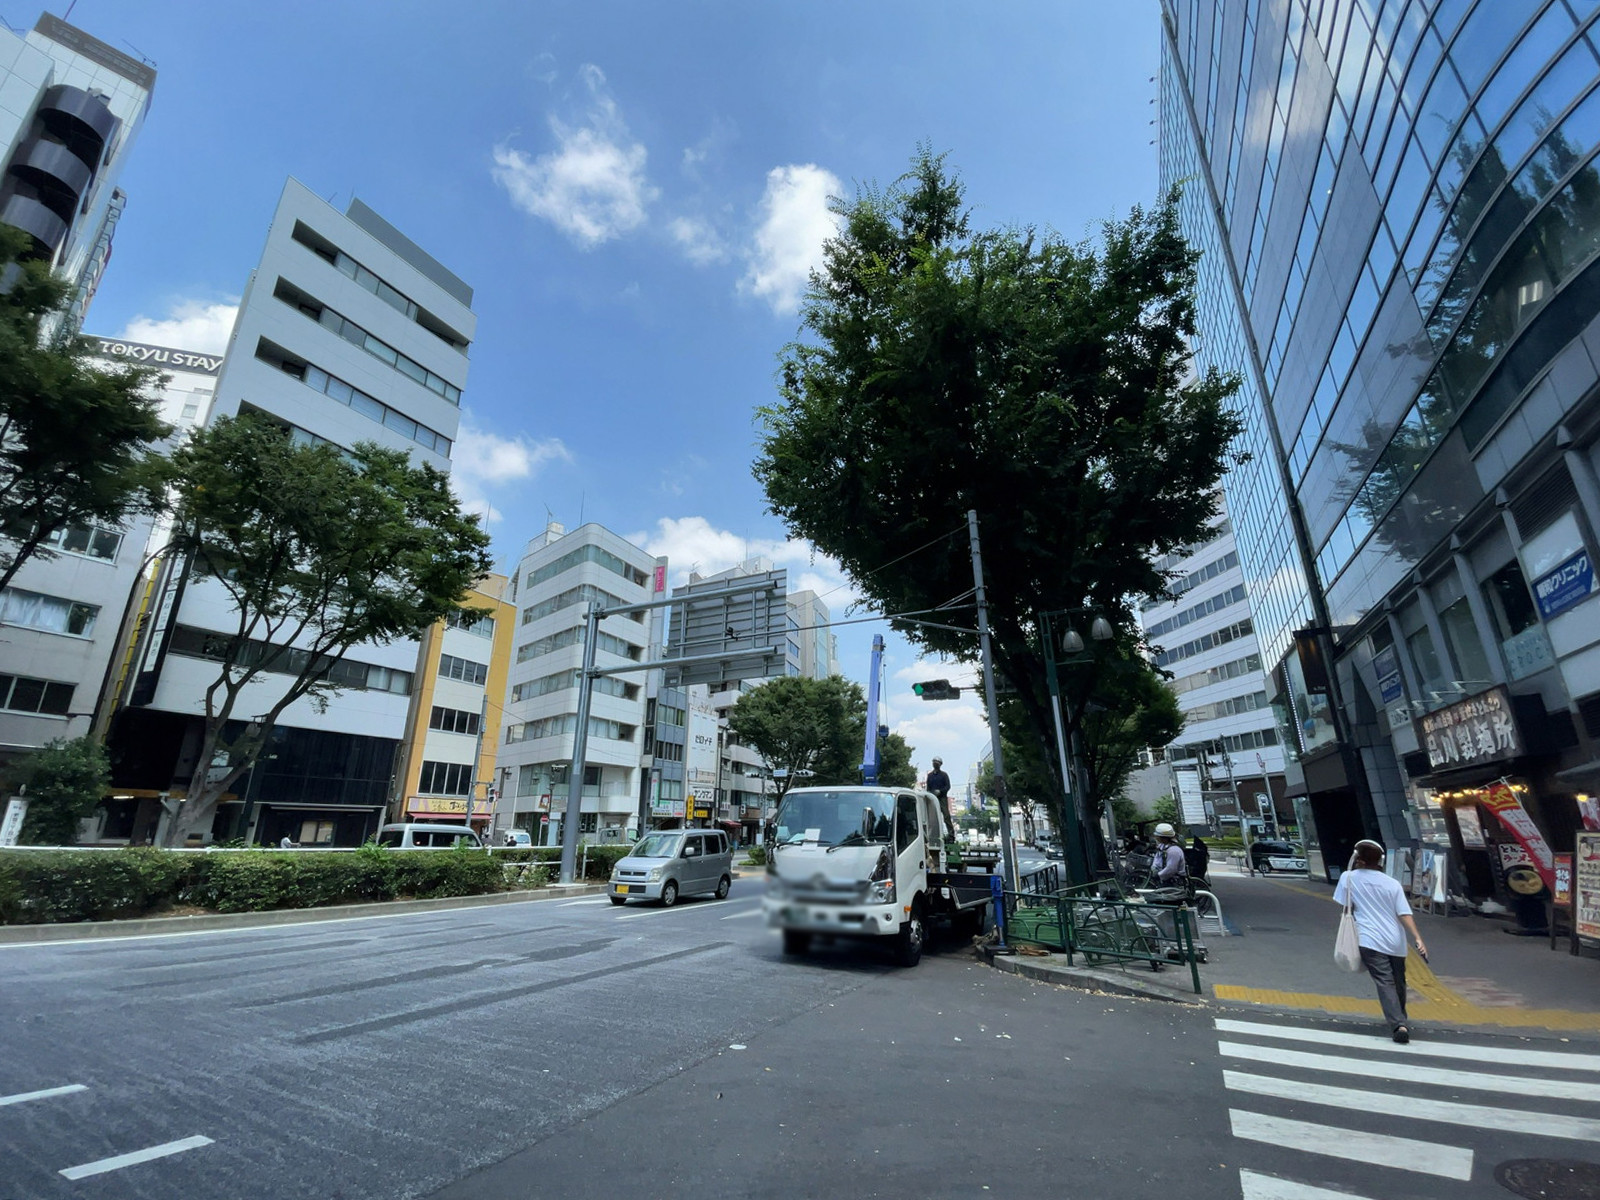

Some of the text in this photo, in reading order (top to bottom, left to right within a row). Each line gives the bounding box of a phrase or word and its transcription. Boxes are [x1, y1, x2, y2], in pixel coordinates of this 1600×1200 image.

[99, 341, 223, 371] TOKYU STAY
[1427, 711, 1516, 768] 品川製麺所
[1500, 844, 1526, 853] とんこ
